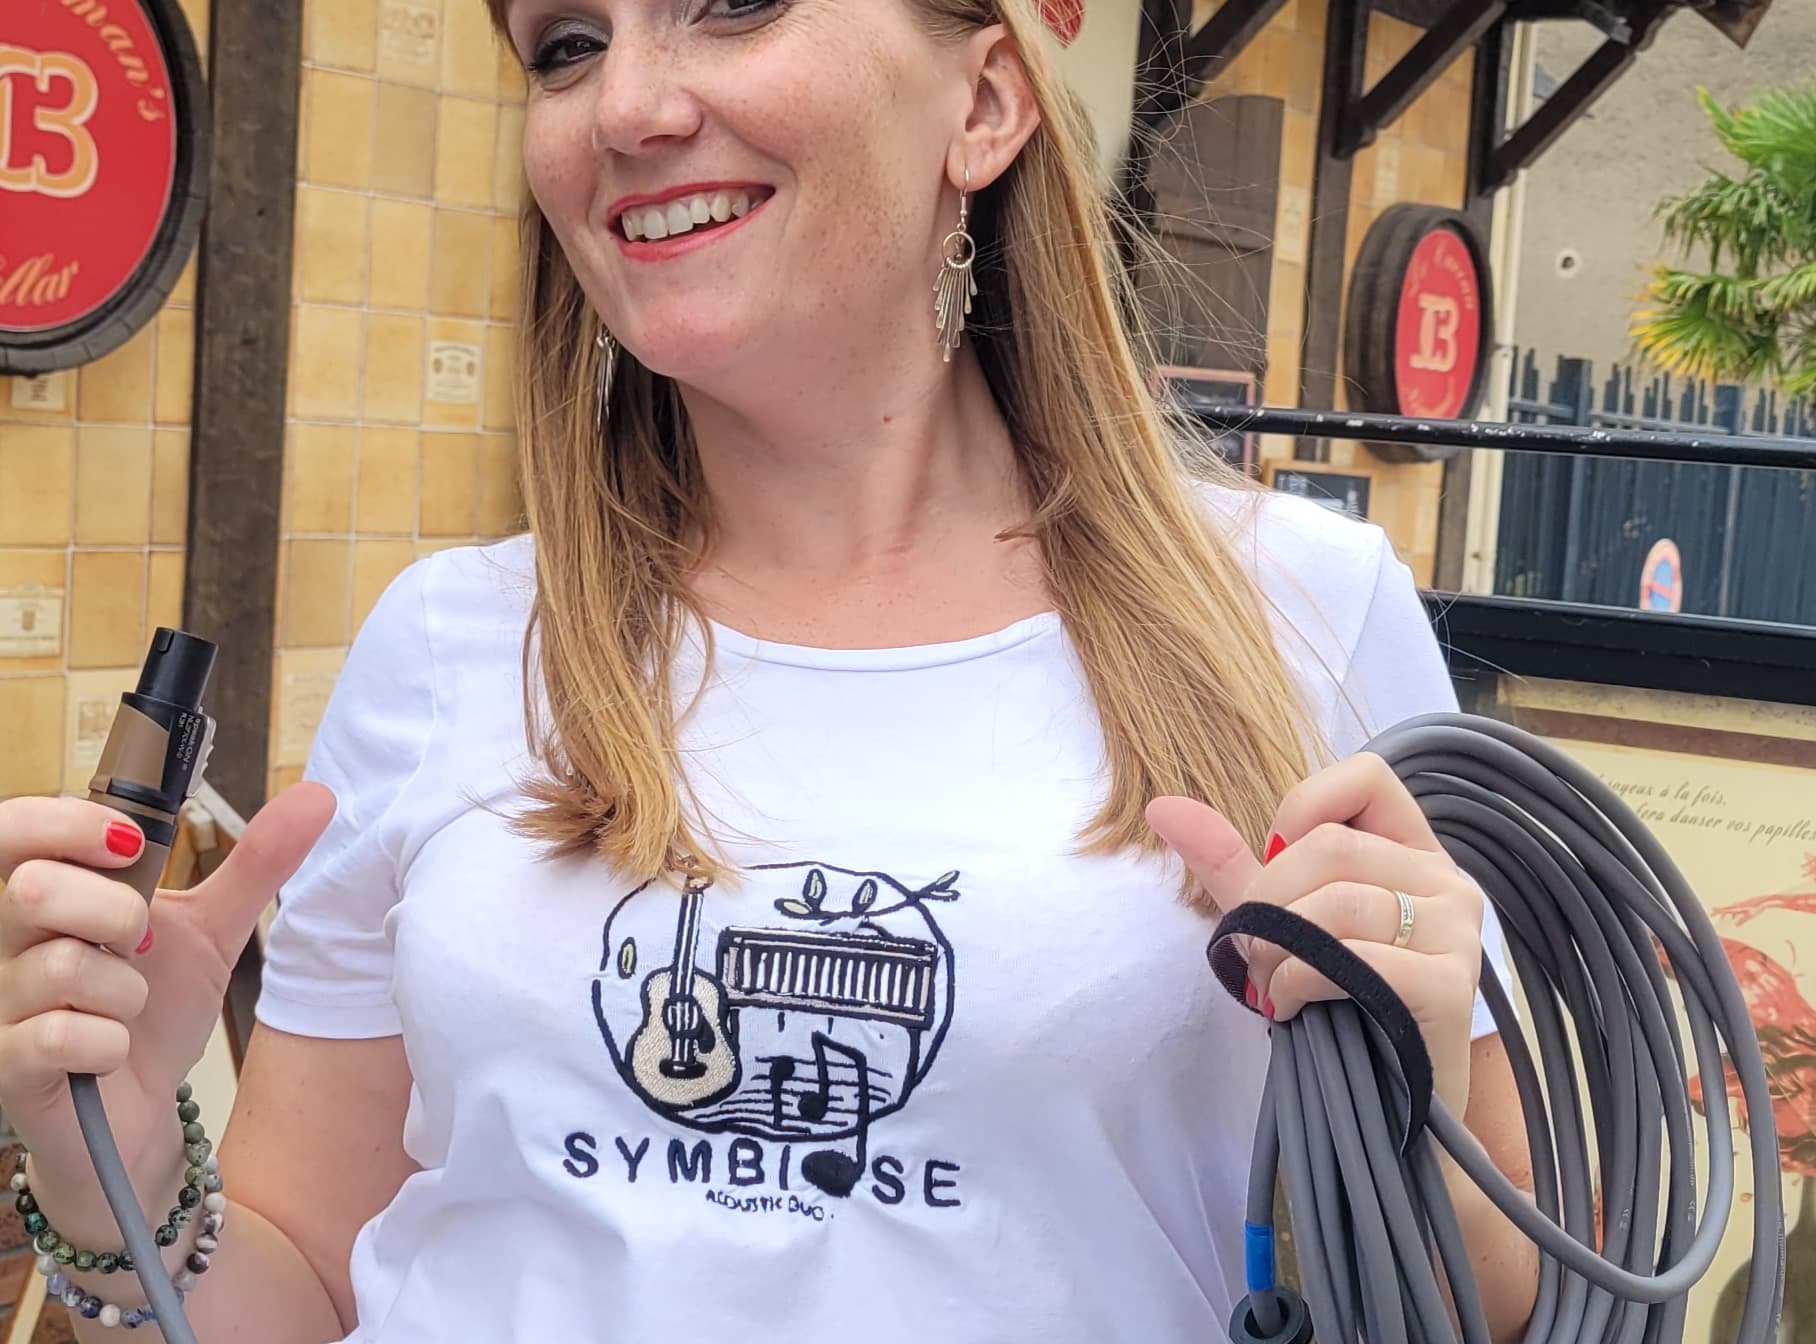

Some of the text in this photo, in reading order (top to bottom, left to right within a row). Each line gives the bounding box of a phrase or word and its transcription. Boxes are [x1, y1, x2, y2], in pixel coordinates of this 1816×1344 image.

[1673, 781, 1689, 800] la
[1669, 805, 1723, 830] danser
[1726, 819, 1752, 832] vos
[705, 1189, 782, 1214] ACOUSTIC
